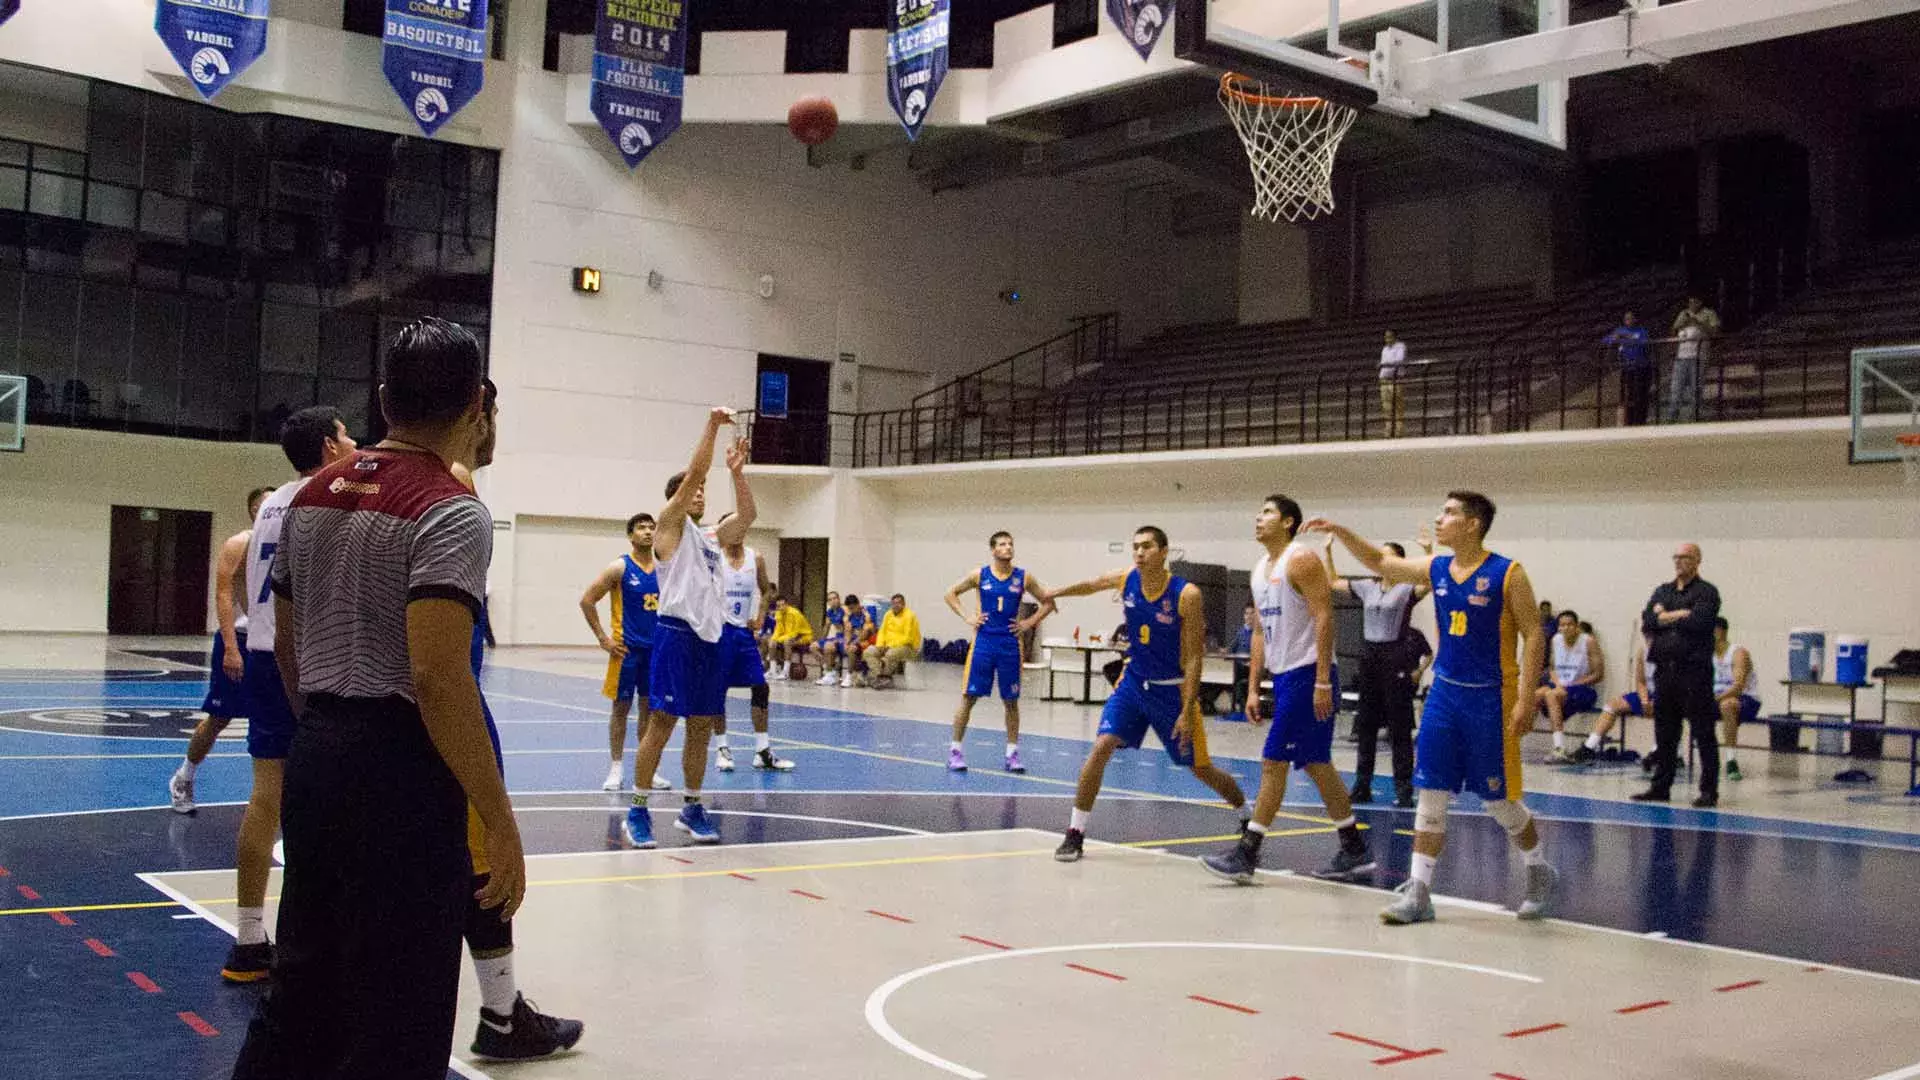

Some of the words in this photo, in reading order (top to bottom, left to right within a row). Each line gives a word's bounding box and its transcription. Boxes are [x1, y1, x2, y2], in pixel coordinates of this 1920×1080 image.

[387, 21, 483, 53] BASQUETBOL
[611, 23, 670, 52] 2014
[621, 60, 653, 76] FLAG
[606, 70, 670, 93] FOOTBALL
[608, 102, 662, 123] FEMENIL
[257, 542, 278, 603] 7
[997, 596, 1004, 612] 1
[1139, 624, 1150, 645] 9
